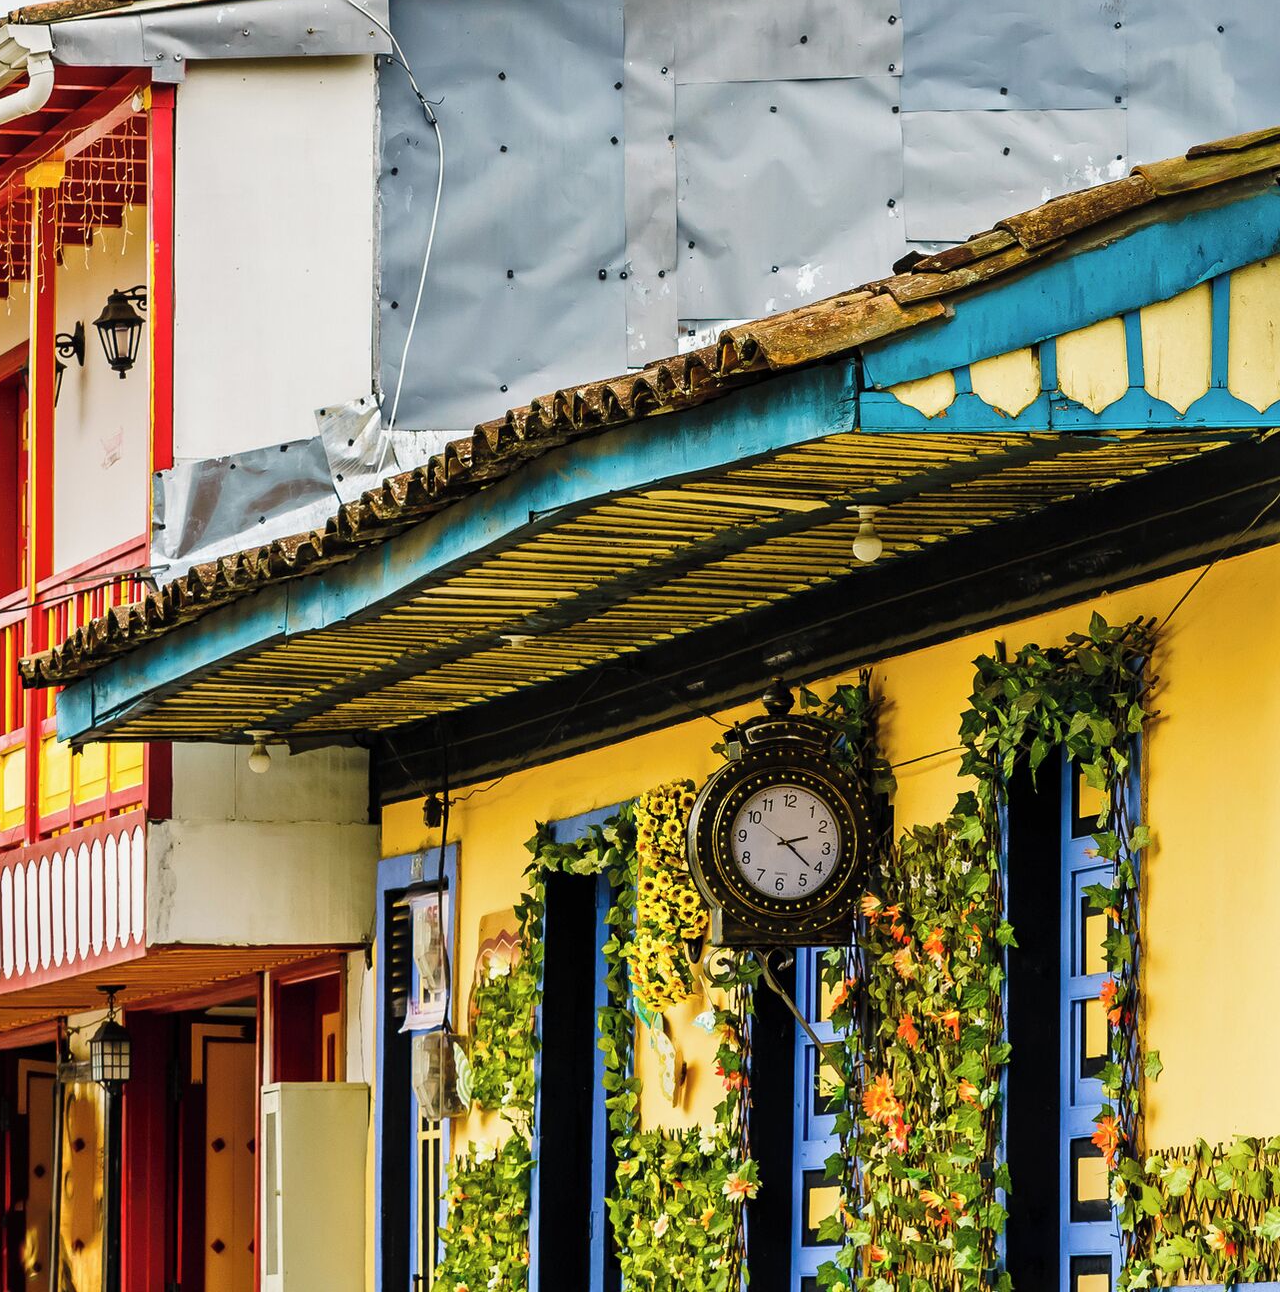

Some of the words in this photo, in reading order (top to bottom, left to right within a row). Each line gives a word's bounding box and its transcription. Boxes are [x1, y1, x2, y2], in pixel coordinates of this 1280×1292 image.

[762, 798, 773, 812] 11
[783, 794, 797, 808] 12
[748, 810, 762, 824] 10
[809, 805, 815, 818] 1
[818, 820, 827, 833] 2
[738, 829, 747, 842] 9
[821, 842, 831, 855] 3
[742, 851, 750, 864] 8
[814, 861, 822, 874] 4
[757, 868, 766, 881] 7
[798, 873, 807, 886] 5
[775, 877, 784, 891] 6
